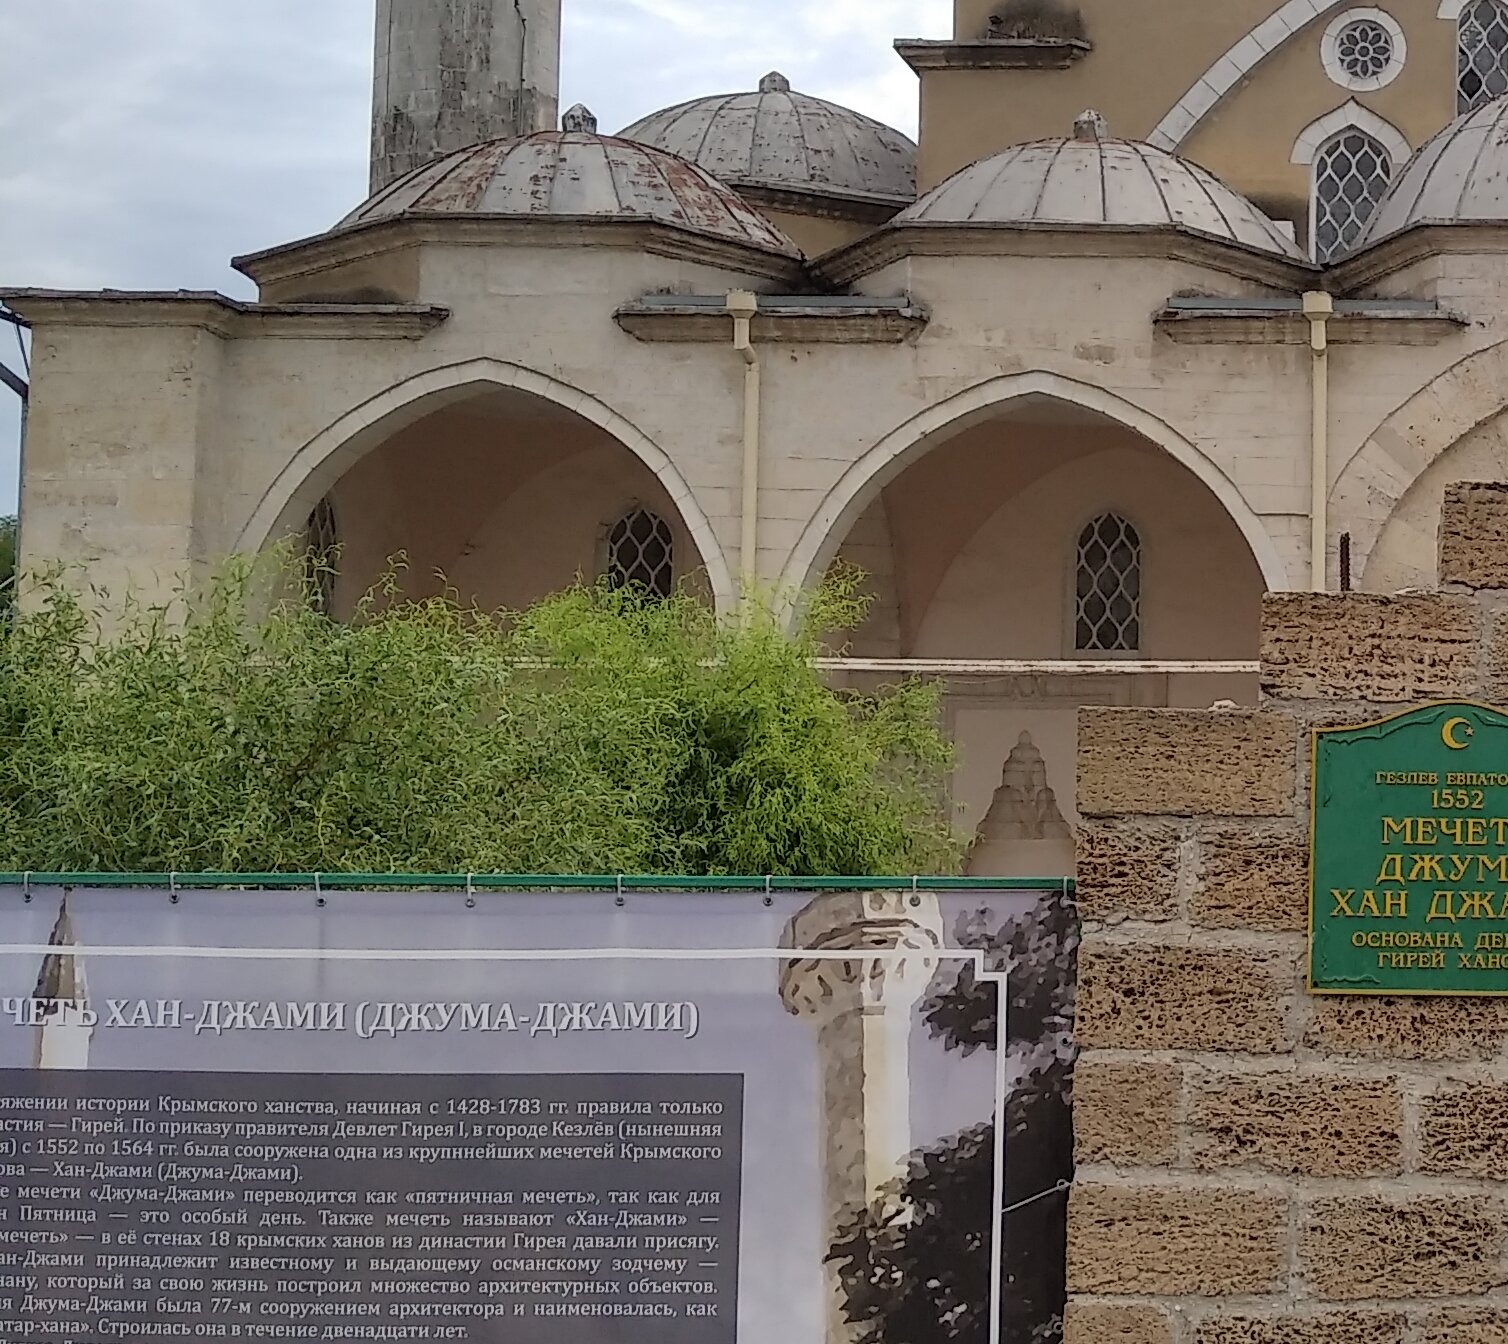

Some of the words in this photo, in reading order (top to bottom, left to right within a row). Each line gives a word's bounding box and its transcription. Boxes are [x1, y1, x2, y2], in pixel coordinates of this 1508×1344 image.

[1376, 772, 1438, 785] ГЕЗЛЕВ
[1432, 789, 1484, 809] 1552
[1331, 889, 1408, 917] ХАН
[1352, 932, 1463, 948] ОСНОВАНА
[1378, 950, 1445, 968] ГИРЕЙ
[2, 997, 98, 1027] ЧЕТЬ
[104, 999, 347, 1036] ХАН-ДЖАМИ
[355, 1001, 700, 1039] (ДЖУМА-ДЖАМИ)
[76, 1098, 149, 1115] истории
[159, 1096, 257, 1116] Крымского
[265, 1102, 338, 1116] ханства,
[346, 1102, 421, 1114] начиная
[447, 1099, 540, 1114] 1428-1783
[577, 1102, 652, 1118] правила
[659, 1102, 722, 1114] только
[72, 1117, 128, 1137] Гирей.
[160, 1122, 232, 1138] приказу
[235, 1123, 329, 1139] правителя
[332, 1121, 398, 1139] Девлет
[401, 1121, 454, 1140] Гирея
[487, 1125, 548, 1140] городе
[552, 1121, 614, 1136] Кезлёв
[619, 1119, 721, 1140] (нынешняя
[37, 1138, 78, 1155] 1552
[112, 1140, 154, 1155] 1564
[184, 1141, 229, 1157] была
[235, 1146, 329, 1162] сооружена
[335, 1147, 376, 1161] одна
[409, 1143, 534, 1163] крупннейших
[540, 1143, 614, 1159] мечетей
[620, 1142, 721, 1163] Крымского
[53, 1161, 152, 1181] Хан-Джами
[158, 1162, 303, 1184] (Джума-Джами).
[18, 1187, 81, 1199] мечети
[90, 1184, 235, 1205] «Джума-Джами»
[244, 1190, 356, 1206] переводится
[366, 1191, 397, 1203] как
[406, 1192, 513, 1204] «пятничная
[523, 1191, 600, 1205] мечеть»,
[608, 1191, 639, 1203] так
[648, 1191, 679, 1203] как
[686, 1191, 720, 1206] для
[20, 1205, 96, 1224] Пятница
[140, 1211, 169, 1223] это
[182, 1207, 247, 1224] особый
[259, 1213, 306, 1227] день.
[318, 1210, 374, 1226] Также
[386, 1214, 450, 1226] мечеть
[463, 1214, 554, 1226] называют
[566, 1210, 687, 1229] «Хан-Джами»
[143, 1233, 202, 1246] стенах
[210, 1231, 230, 1246] 18
[237, 1235, 327, 1251] крымских
[333, 1236, 384, 1248] ханов
[418, 1236, 506, 1251] династии
[514, 1233, 566, 1252] Гирея
[573, 1236, 637, 1251] давали
[645, 1236, 719, 1253] присягу.
[96, 1255, 218, 1272] принадлежит
[229, 1257, 334, 1274] известному
[370, 1258, 481, 1274] выдающему
[493, 1259, 601, 1274] османскому
[612, 1259, 687, 1275] зодчему
[48, 1272, 124, 1293] который
[160, 1278, 203, 1291] свою
[212, 1279, 268, 1292] жизнь
[277, 1280, 361, 1297] построил
[371, 1281, 470, 1294] множество
[479, 1281, 620, 1297] архитектурных
[629, 1277, 717, 1294] объектов.
[20, 1294, 147, 1316] Джума-Джами
[157, 1296, 201, 1313] была
[211, 1298, 251, 1314] 77-м
[260, 1302, 380, 1319] сооружением
[389, 1303, 504, 1320] архитектора
[534, 1303, 677, 1318] наименовалась,
[686, 1304, 717, 1316] как
[98, 1318, 191, 1339] Строилась
[195, 1324, 226, 1336] она
[245, 1325, 318, 1338] течение
[321, 1325, 429, 1341] двенадцати
[433, 1326, 468, 1338] лет.
